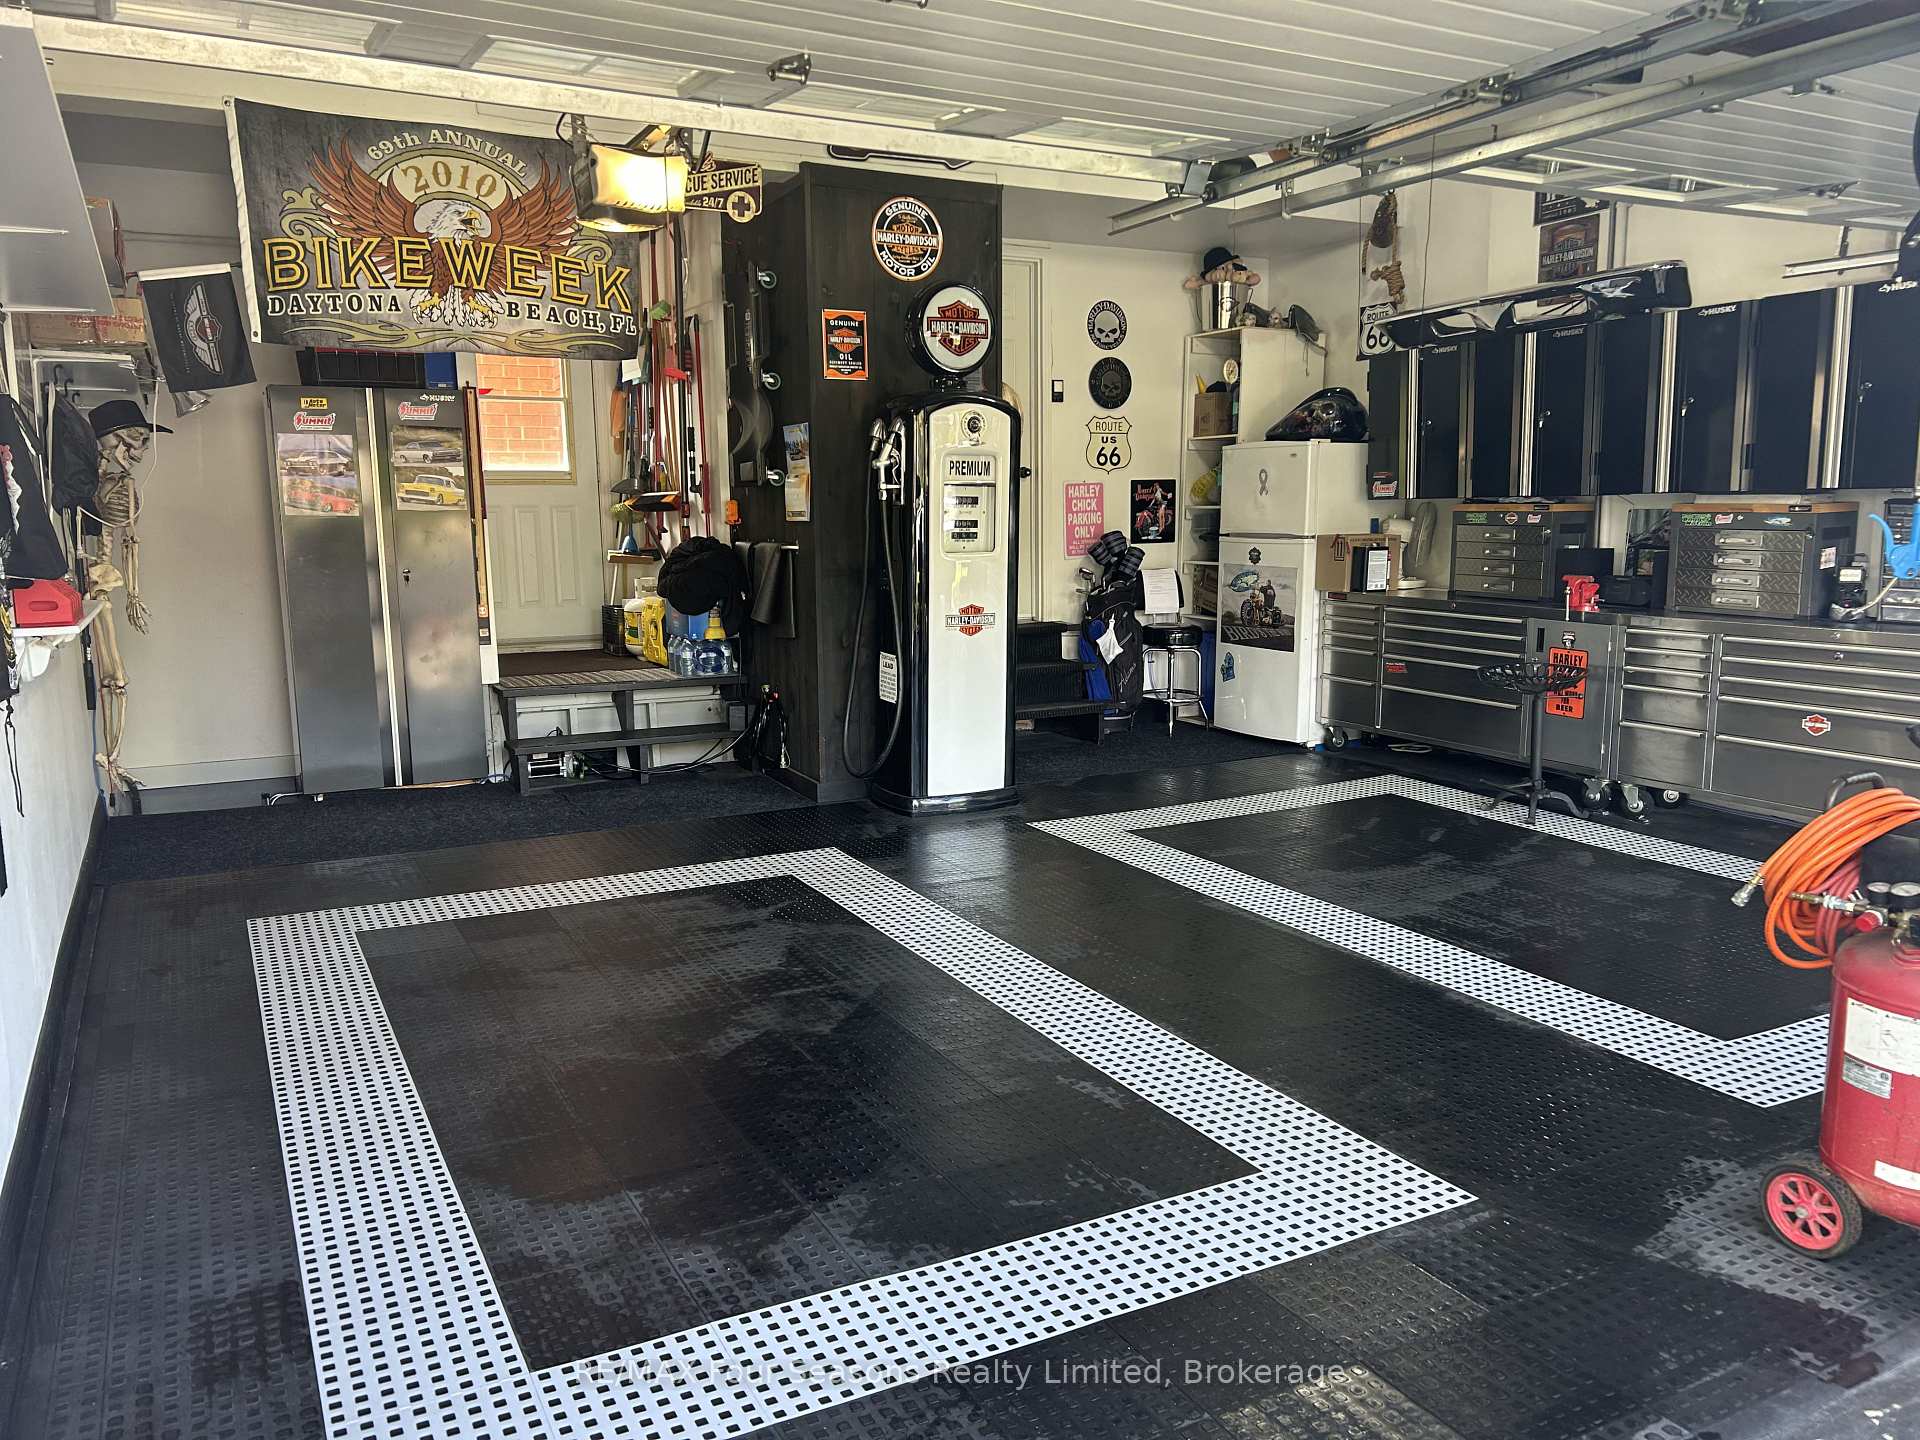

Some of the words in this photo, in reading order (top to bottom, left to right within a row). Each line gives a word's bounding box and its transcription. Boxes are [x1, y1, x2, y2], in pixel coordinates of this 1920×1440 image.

[366, 130, 422, 161] 69th
[427, 128, 528, 178] ANNUAL
[403, 160, 498, 199] 2010
[685, 175, 708, 193] CUE
[711, 167, 759, 190] SERVICE
[702, 197, 724, 208] 24/7
[885, 201, 928, 220] GENUINE
[877, 230, 938, 248] HARLEY-DAVIDSON
[880, 250, 916, 277] MOTOR
[920, 256, 936, 272] OIL
[262, 235, 433, 292] BIKE
[438, 238, 637, 314] WEEK
[267, 291, 402, 317] DAYTONA
[506, 301, 607, 334] BEACH,
[609, 314, 637, 336] FL
[945, 305, 975, 319] MOTOR
[1088, 301, 1127, 331] HARLEY-DAVIDSON
[1707, 304, 1737, 315] HUSKY
[829, 319, 859, 327] GENUINE
[931, 320, 986, 335] HARLEY-DAVIDSON
[1366, 325, 1390, 350] 66
[1560, 327, 1585, 337] HUSKY
[839, 353, 853, 361] OIL
[1095, 421, 1123, 432] ROUTE
[1096, 446, 1121, 467] 66
[949, 460, 991, 476] PREMIUM
[1068, 484, 1101, 498] HARLEY
[1071, 499, 1097, 511] CHICK
[1068, 512, 1102, 525] PARKING
[1074, 526, 1096, 539] ONLY
[947, 615, 995, 626] HARLEY-DAVIDSON
[1553, 652, 1584, 667] HARLEY
[1555, 704, 1574, 713] BEER
